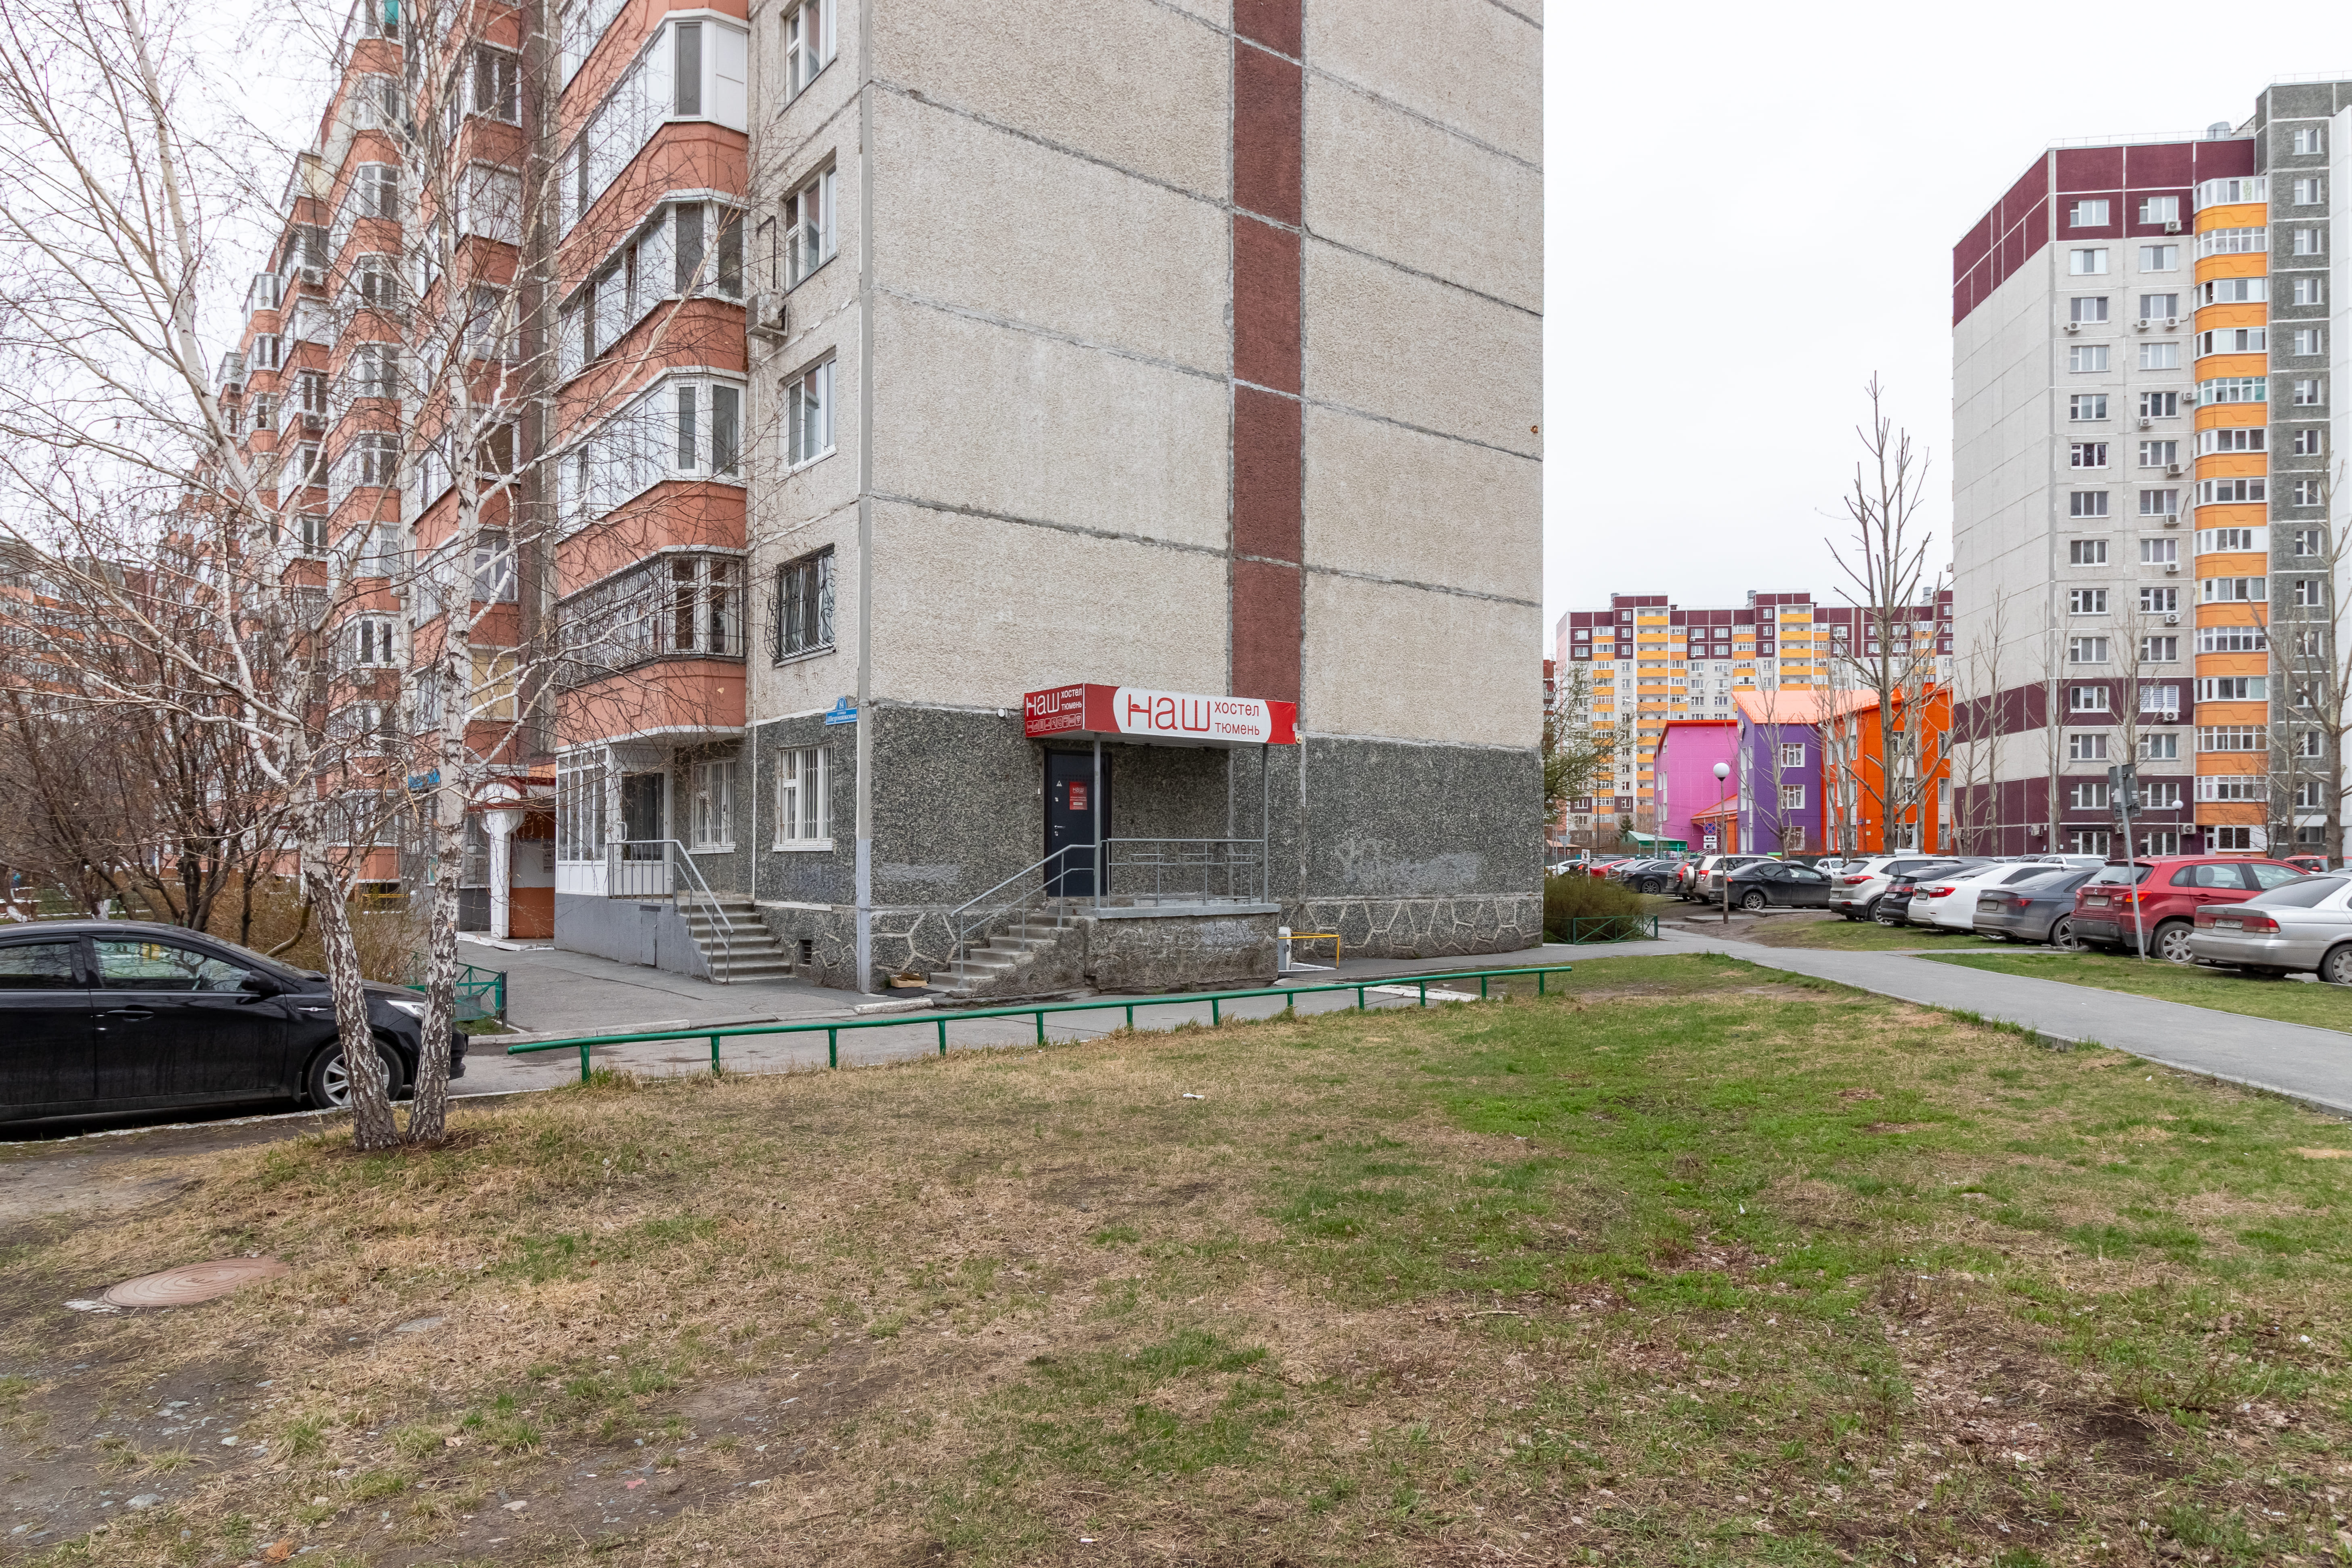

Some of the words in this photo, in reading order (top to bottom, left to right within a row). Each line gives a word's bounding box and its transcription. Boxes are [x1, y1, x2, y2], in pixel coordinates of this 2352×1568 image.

[1061, 688, 1082, 699] хостел
[839, 699, 844, 709] 84
[1061, 701, 1082, 710] тюмень
[1215, 701, 1259, 716] хостел
[828, 714, 856, 722] Пермякова
[1215, 722, 1260, 735] тюмень
